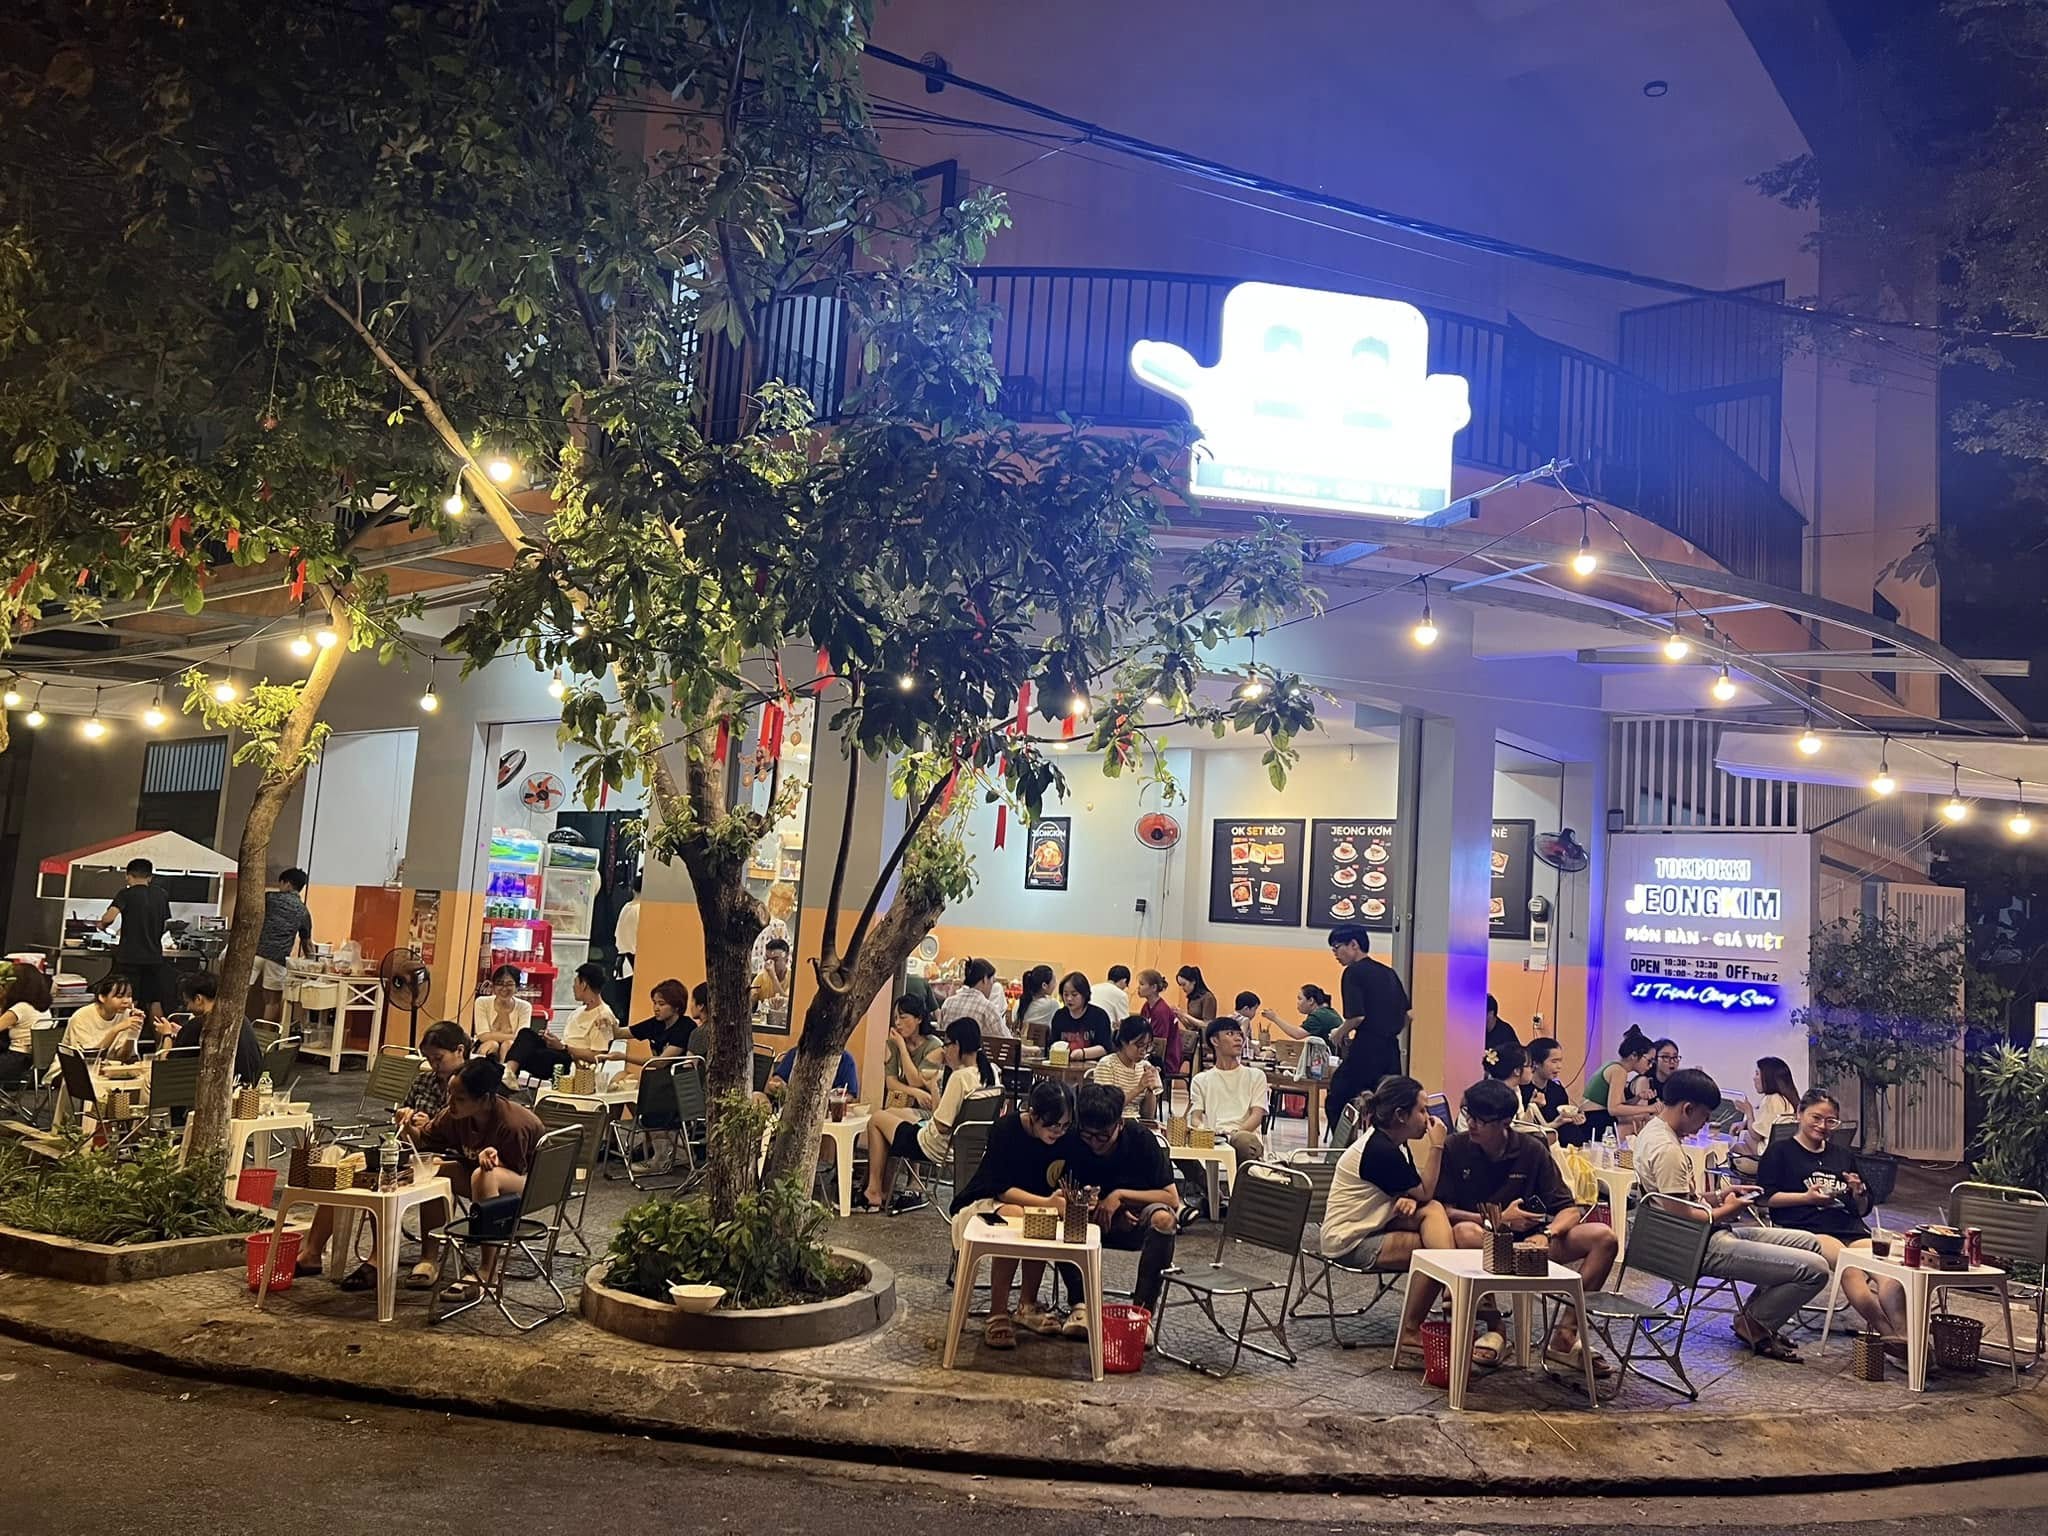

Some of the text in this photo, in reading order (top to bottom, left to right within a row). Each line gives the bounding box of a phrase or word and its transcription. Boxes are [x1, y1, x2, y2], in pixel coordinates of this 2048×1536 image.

[1231, 826, 1245, 836] OK
[1246, 826, 1264, 836] SET
[1330, 826, 1366, 836] JEONG
[1625, 884, 1780, 920] JEONGKIM
[1713, 930, 1742, 948] GIÁ
[1631, 958, 1660, 974] OPEN
[1726, 964, 1749, 980] OFF
[1771, 973, 1778, 982] 2
